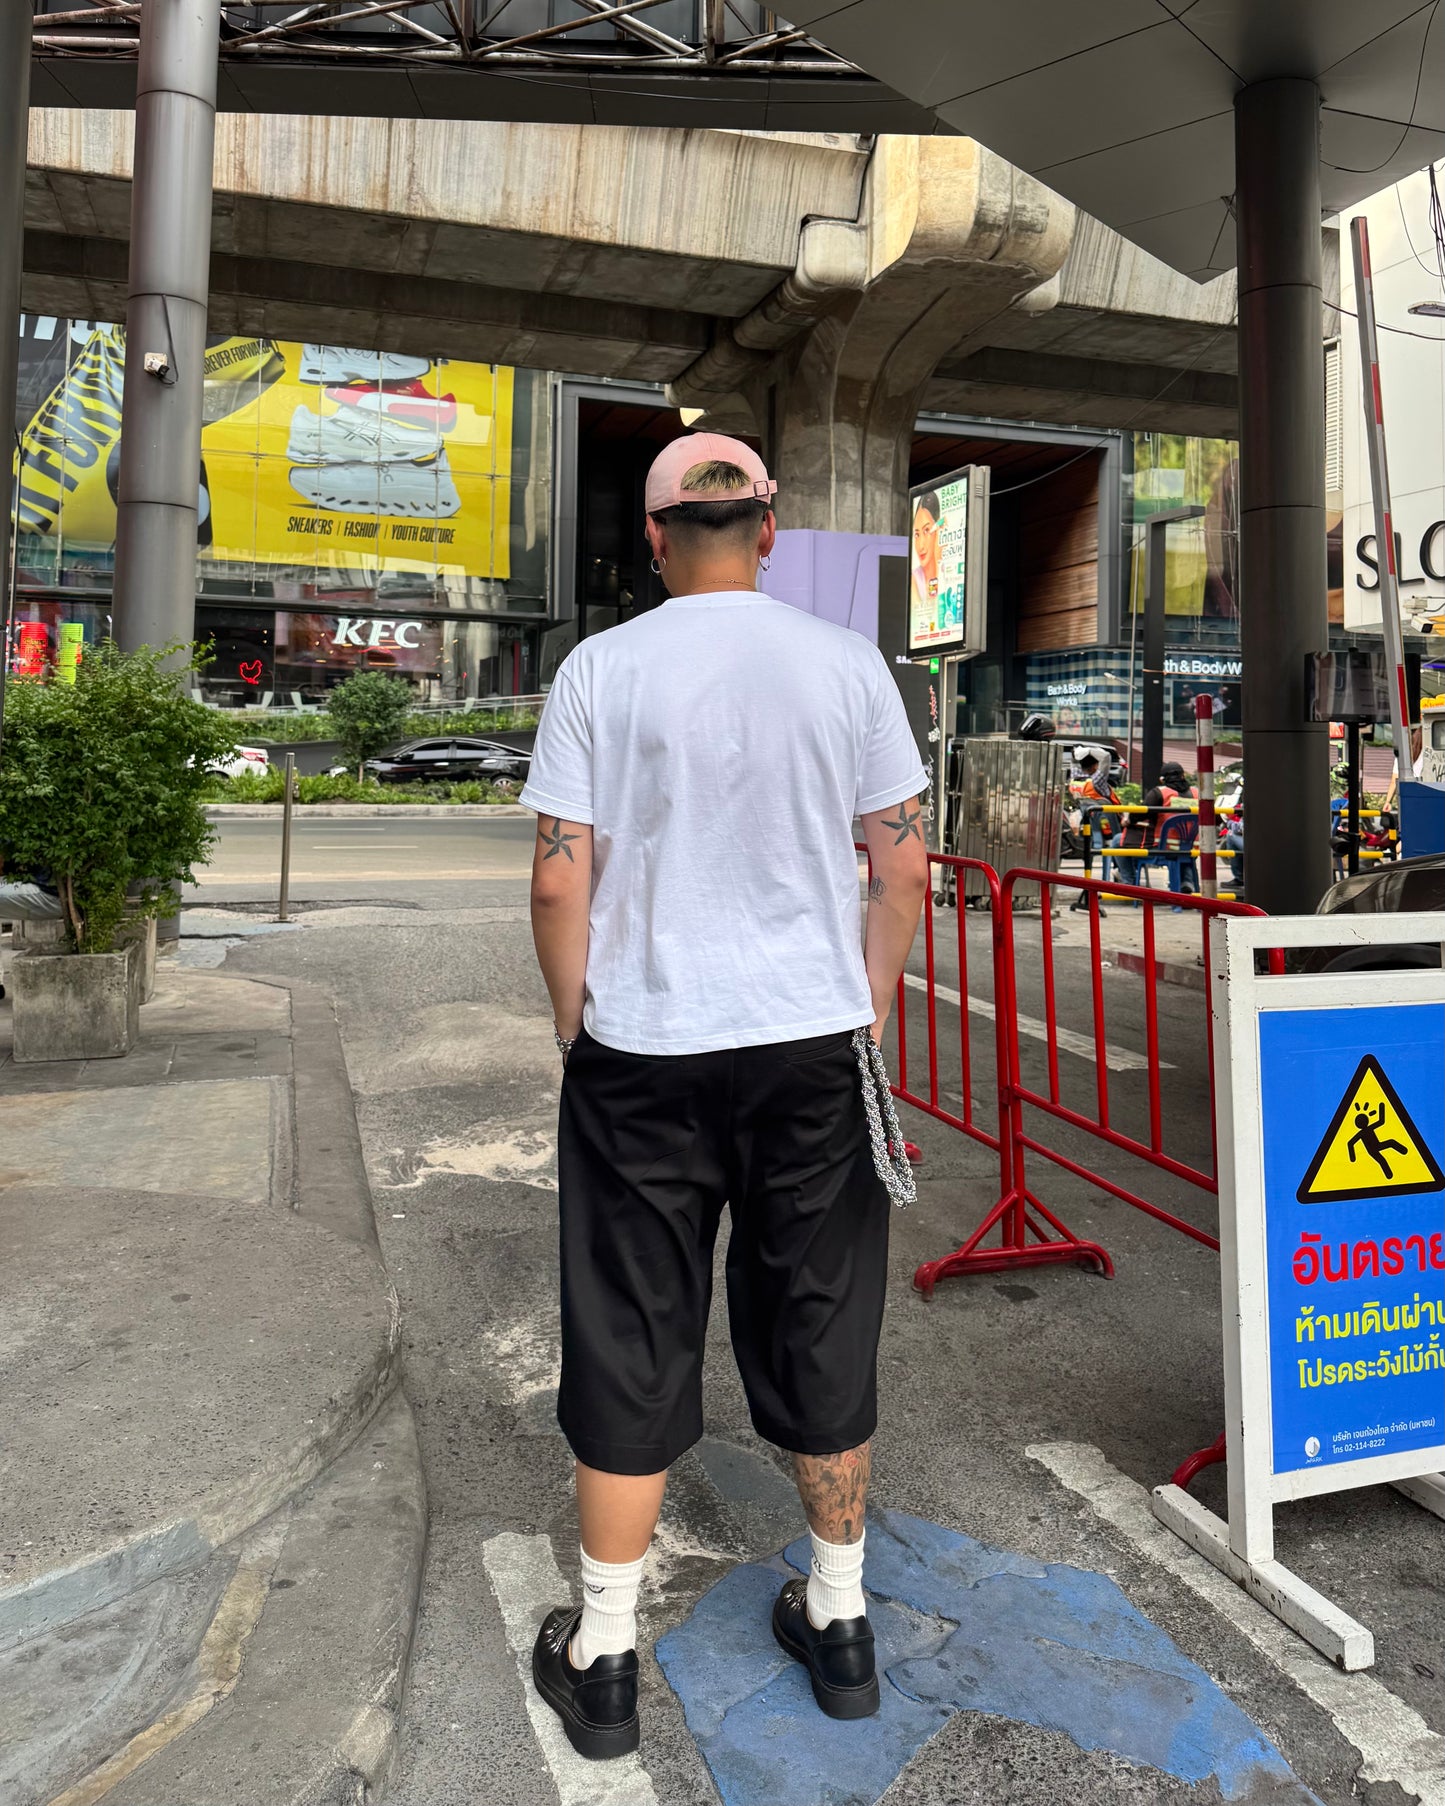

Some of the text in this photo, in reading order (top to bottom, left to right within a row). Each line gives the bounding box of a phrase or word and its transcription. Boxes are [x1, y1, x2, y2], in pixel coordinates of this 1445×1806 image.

[204, 349, 231, 375] OREVER
[287, 516, 456, 545] SNEAKERS FASHION YOUTH CULTURE
[333, 618, 422, 647] KFC
[1163, 658, 1243, 676] th & Body W
[1068, 683, 1087, 696] Body
[1332, 1438, 1385, 1453] โทร 02-114-8222
